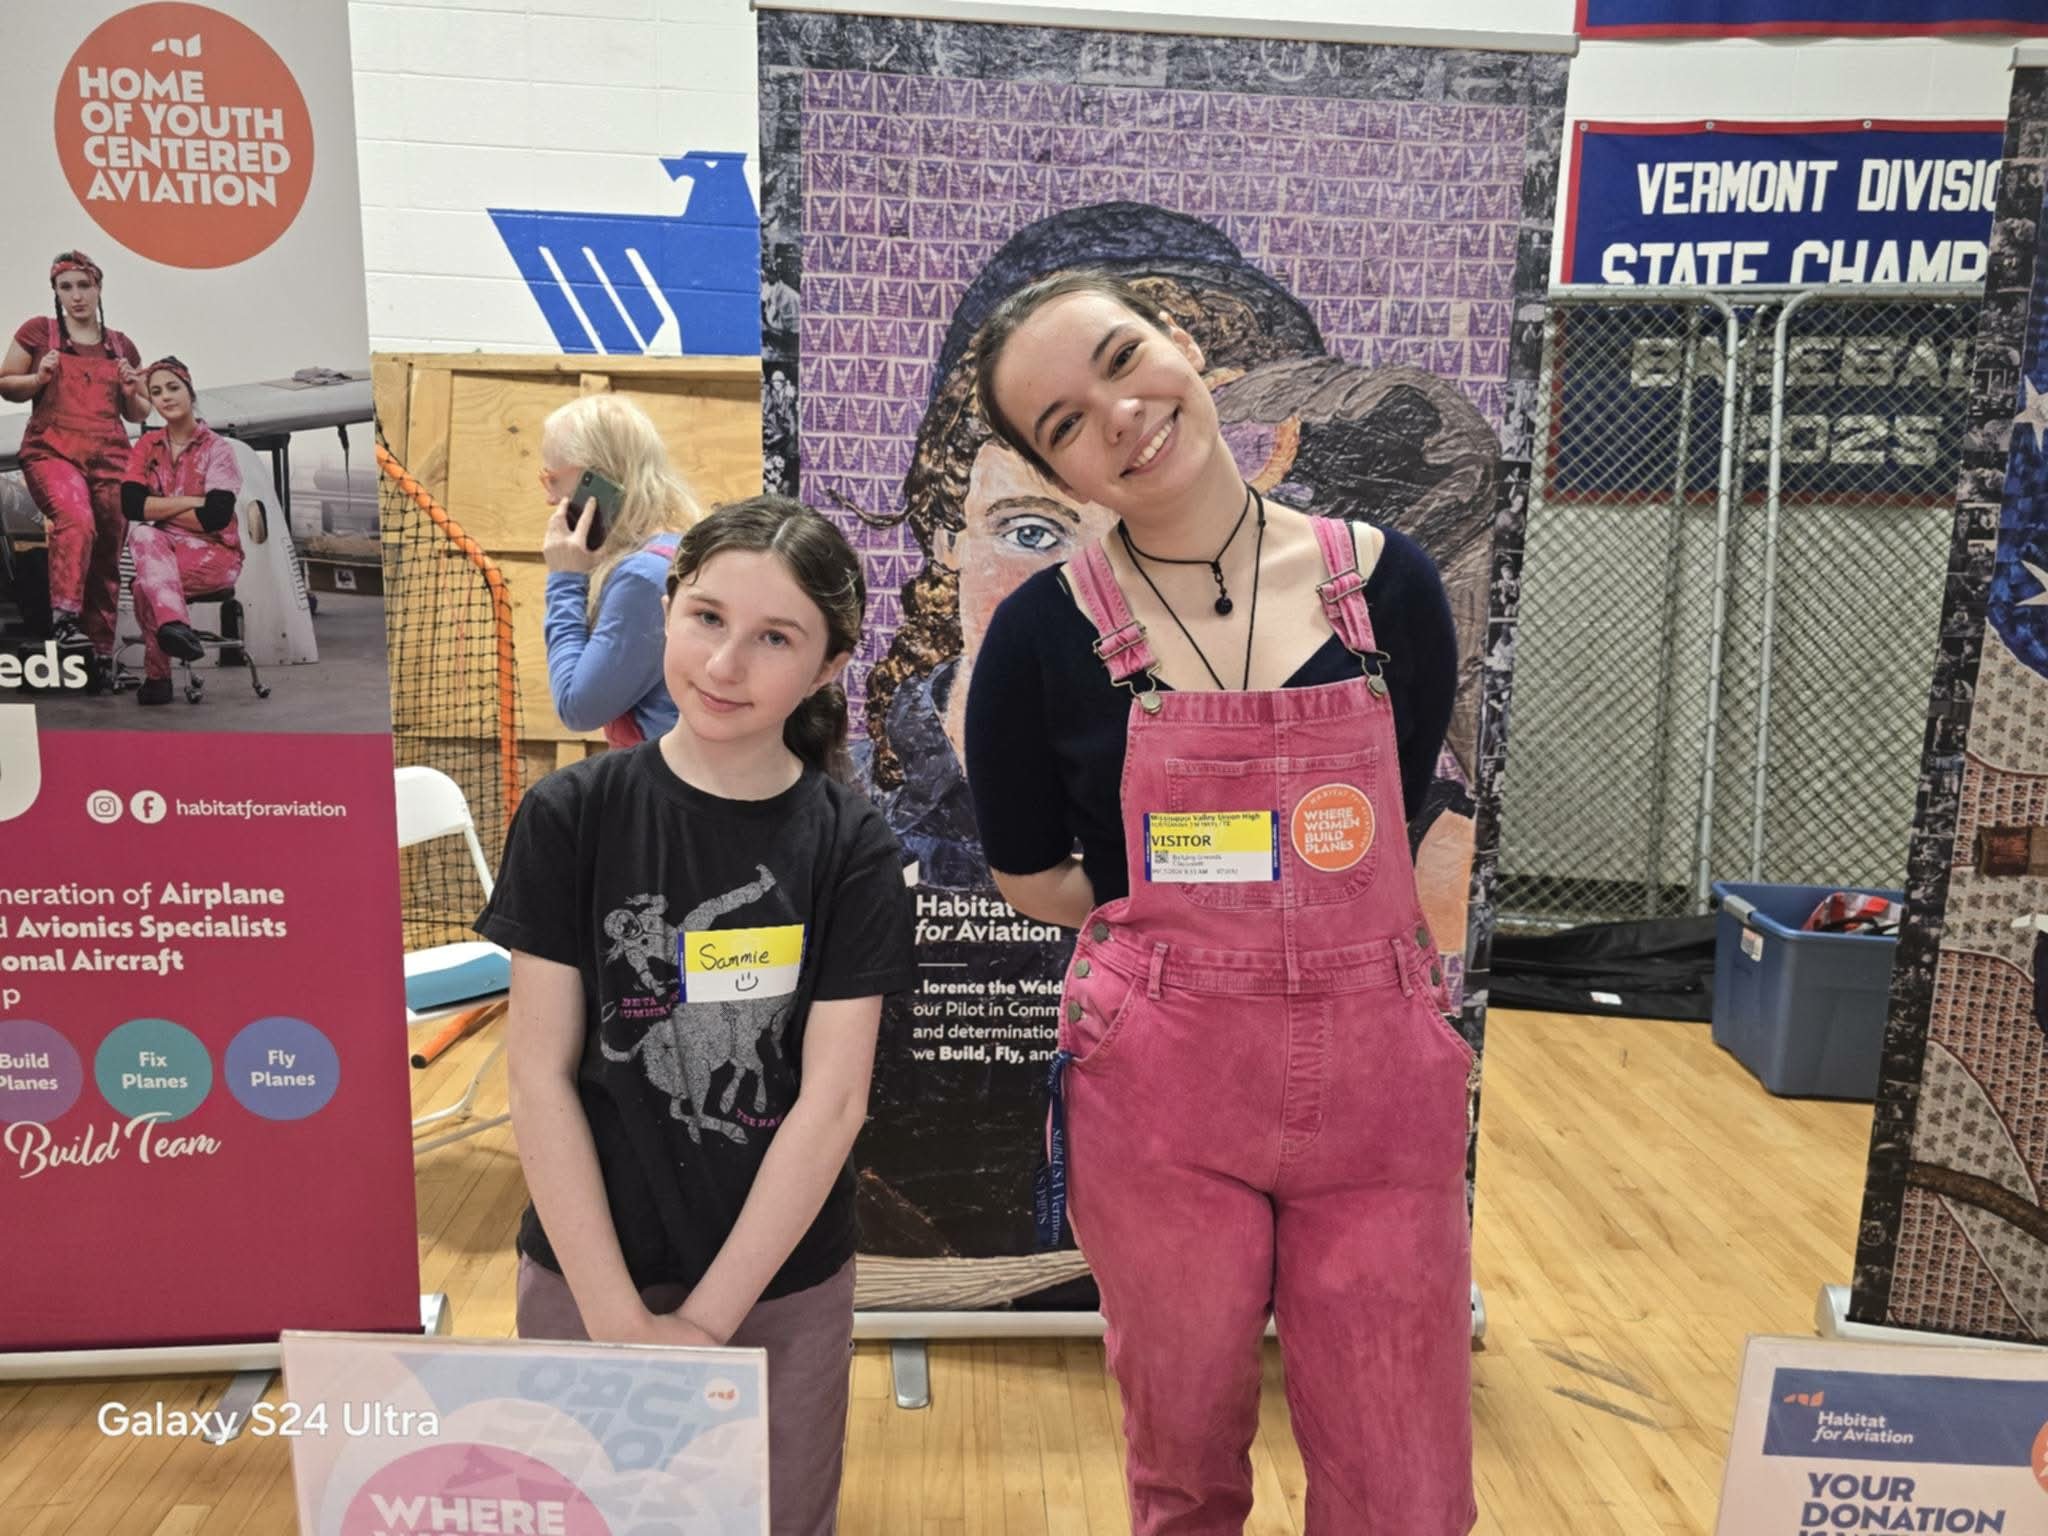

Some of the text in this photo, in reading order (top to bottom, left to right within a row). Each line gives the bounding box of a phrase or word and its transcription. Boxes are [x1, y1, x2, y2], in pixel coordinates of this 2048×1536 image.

[79, 66, 205, 102] HOME
[81, 102, 283, 140] OF YOUTH
[84, 136, 291, 174] CENTERED
[87, 170, 277, 207] AVIATION
[1637, 160, 1838, 215] VERMONT
[1601, 240, 1990, 284] STATE CHAMP
[0, 640, 88, 689] eds
[176, 799, 347, 819] habitatforaviation
[1303, 806, 1354, 822] WHERE
[1303, 816, 1361, 832] WOMEN
[1151, 833, 1212, 848] VISITOR
[1304, 829, 1345, 845] BUILD
[1304, 839, 1355, 856] PLANES
[123, 882, 152, 909] of
[160, 882, 284, 909] Airplane
[16, 915, 133, 939] Avionics
[140, 915, 287, 942] Specialists
[914, 919, 1061, 945] for Aviation
[72, 948, 184, 976] Aircraft
[699, 943, 770, 971] Sammie
[914, 979, 1063, 995] lorence the Weld
[913, 1001, 1060, 1017] our Pilot in Comm
[912, 1023, 944, 1039] and
[0, 1053, 49, 1070] Build
[139, 1051, 168, 1068] Fix
[268, 1050, 296, 1069] Fly
[912, 1048, 935, 1061] we
[939, 1045, 991, 1064] Build,
[995, 1045, 1025, 1064] Fly,
[122, 1073, 188, 1090] Planes
[250, 1071, 316, 1088] Planes
[4, 1111, 222, 1179] Build Team
[1818, 1411, 1886, 1429] Habitat
[1812, 1427, 1914, 1445] for Aviation
[1808, 1472, 1916, 1502] YOUR
[369, 1493, 565, 1536] WHERE
[1801, 1502, 2006, 1535] DONATION
